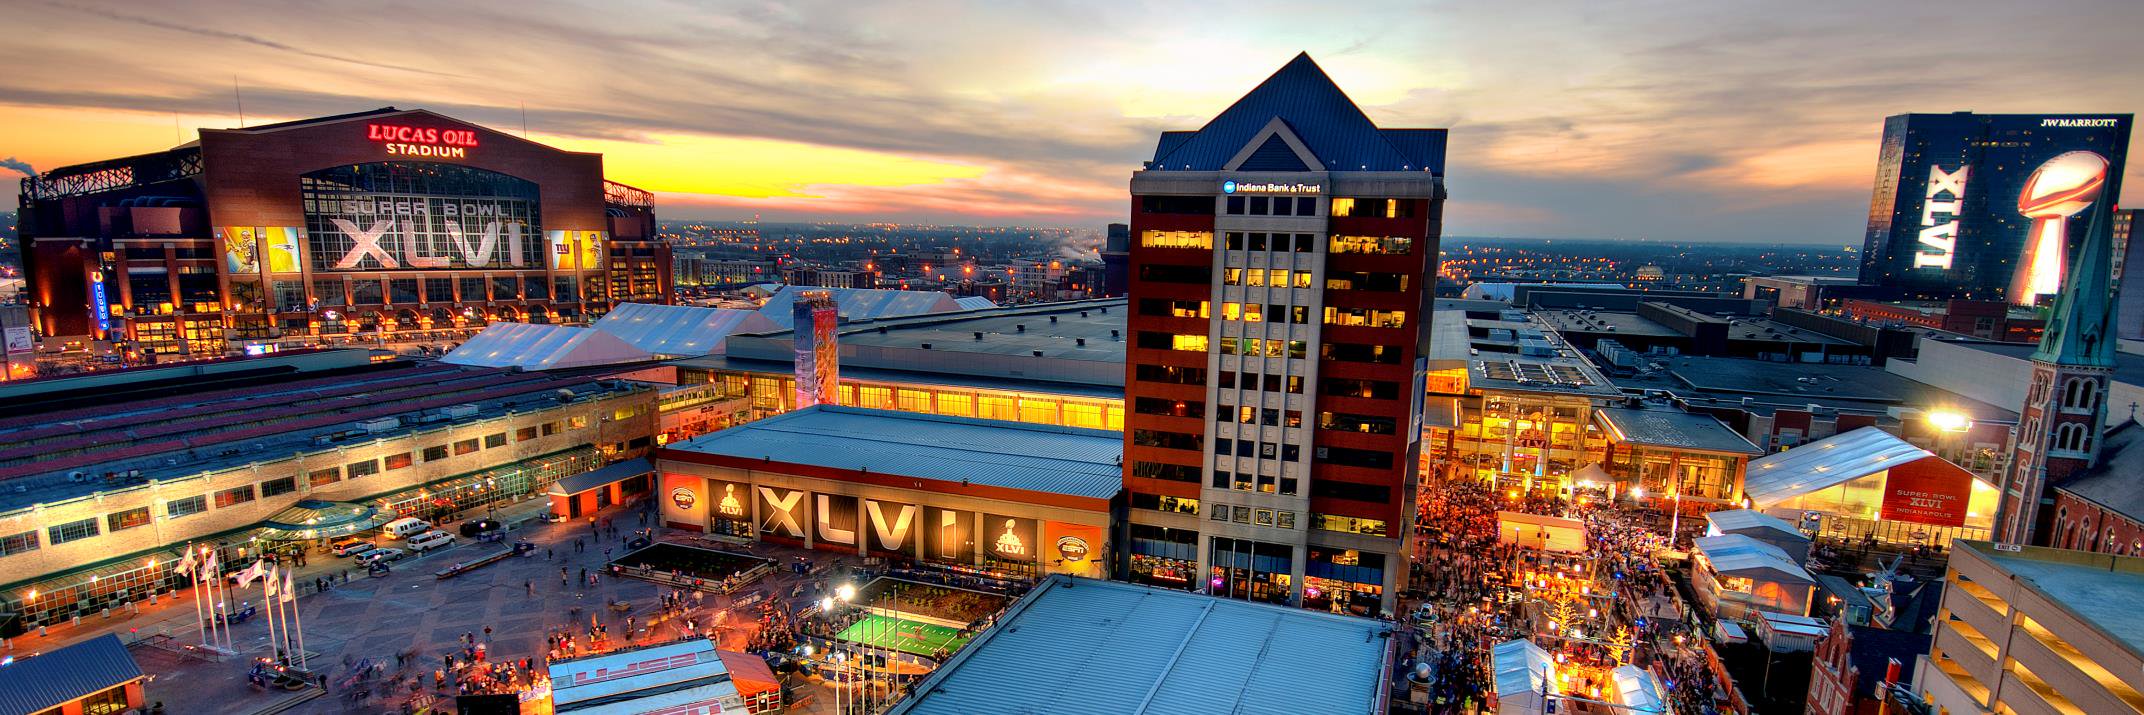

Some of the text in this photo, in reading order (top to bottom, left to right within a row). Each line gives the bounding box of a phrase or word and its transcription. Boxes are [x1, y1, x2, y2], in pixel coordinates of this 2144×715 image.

[2041, 118, 2118, 127] JW MARRIOTT
[368, 124, 478, 147] LUCAS OIL
[386, 142, 464, 158] STADIUM
[1236, 183, 1266, 192] Indiana
[1267, 183, 1289, 193] Bank
[1290, 185, 1297, 193] &
[1297, 184, 1321, 193] Trust
[341, 201, 510, 217] SUPER BOWL
[1913, 164, 1969, 270] XLVI
[328, 218, 525, 269] XLVI
[1896, 489, 1958, 501] SUPER BOWL
[1909, 497, 1943, 509] XLVI
[719, 505, 743, 516] XLVI
[1896, 507, 1953, 518] INDIANAPOLIS
[758, 486, 957, 559] XLVI
[995, 542, 1025, 555] XLVI
[1061, 544, 1084, 554] ESPN
